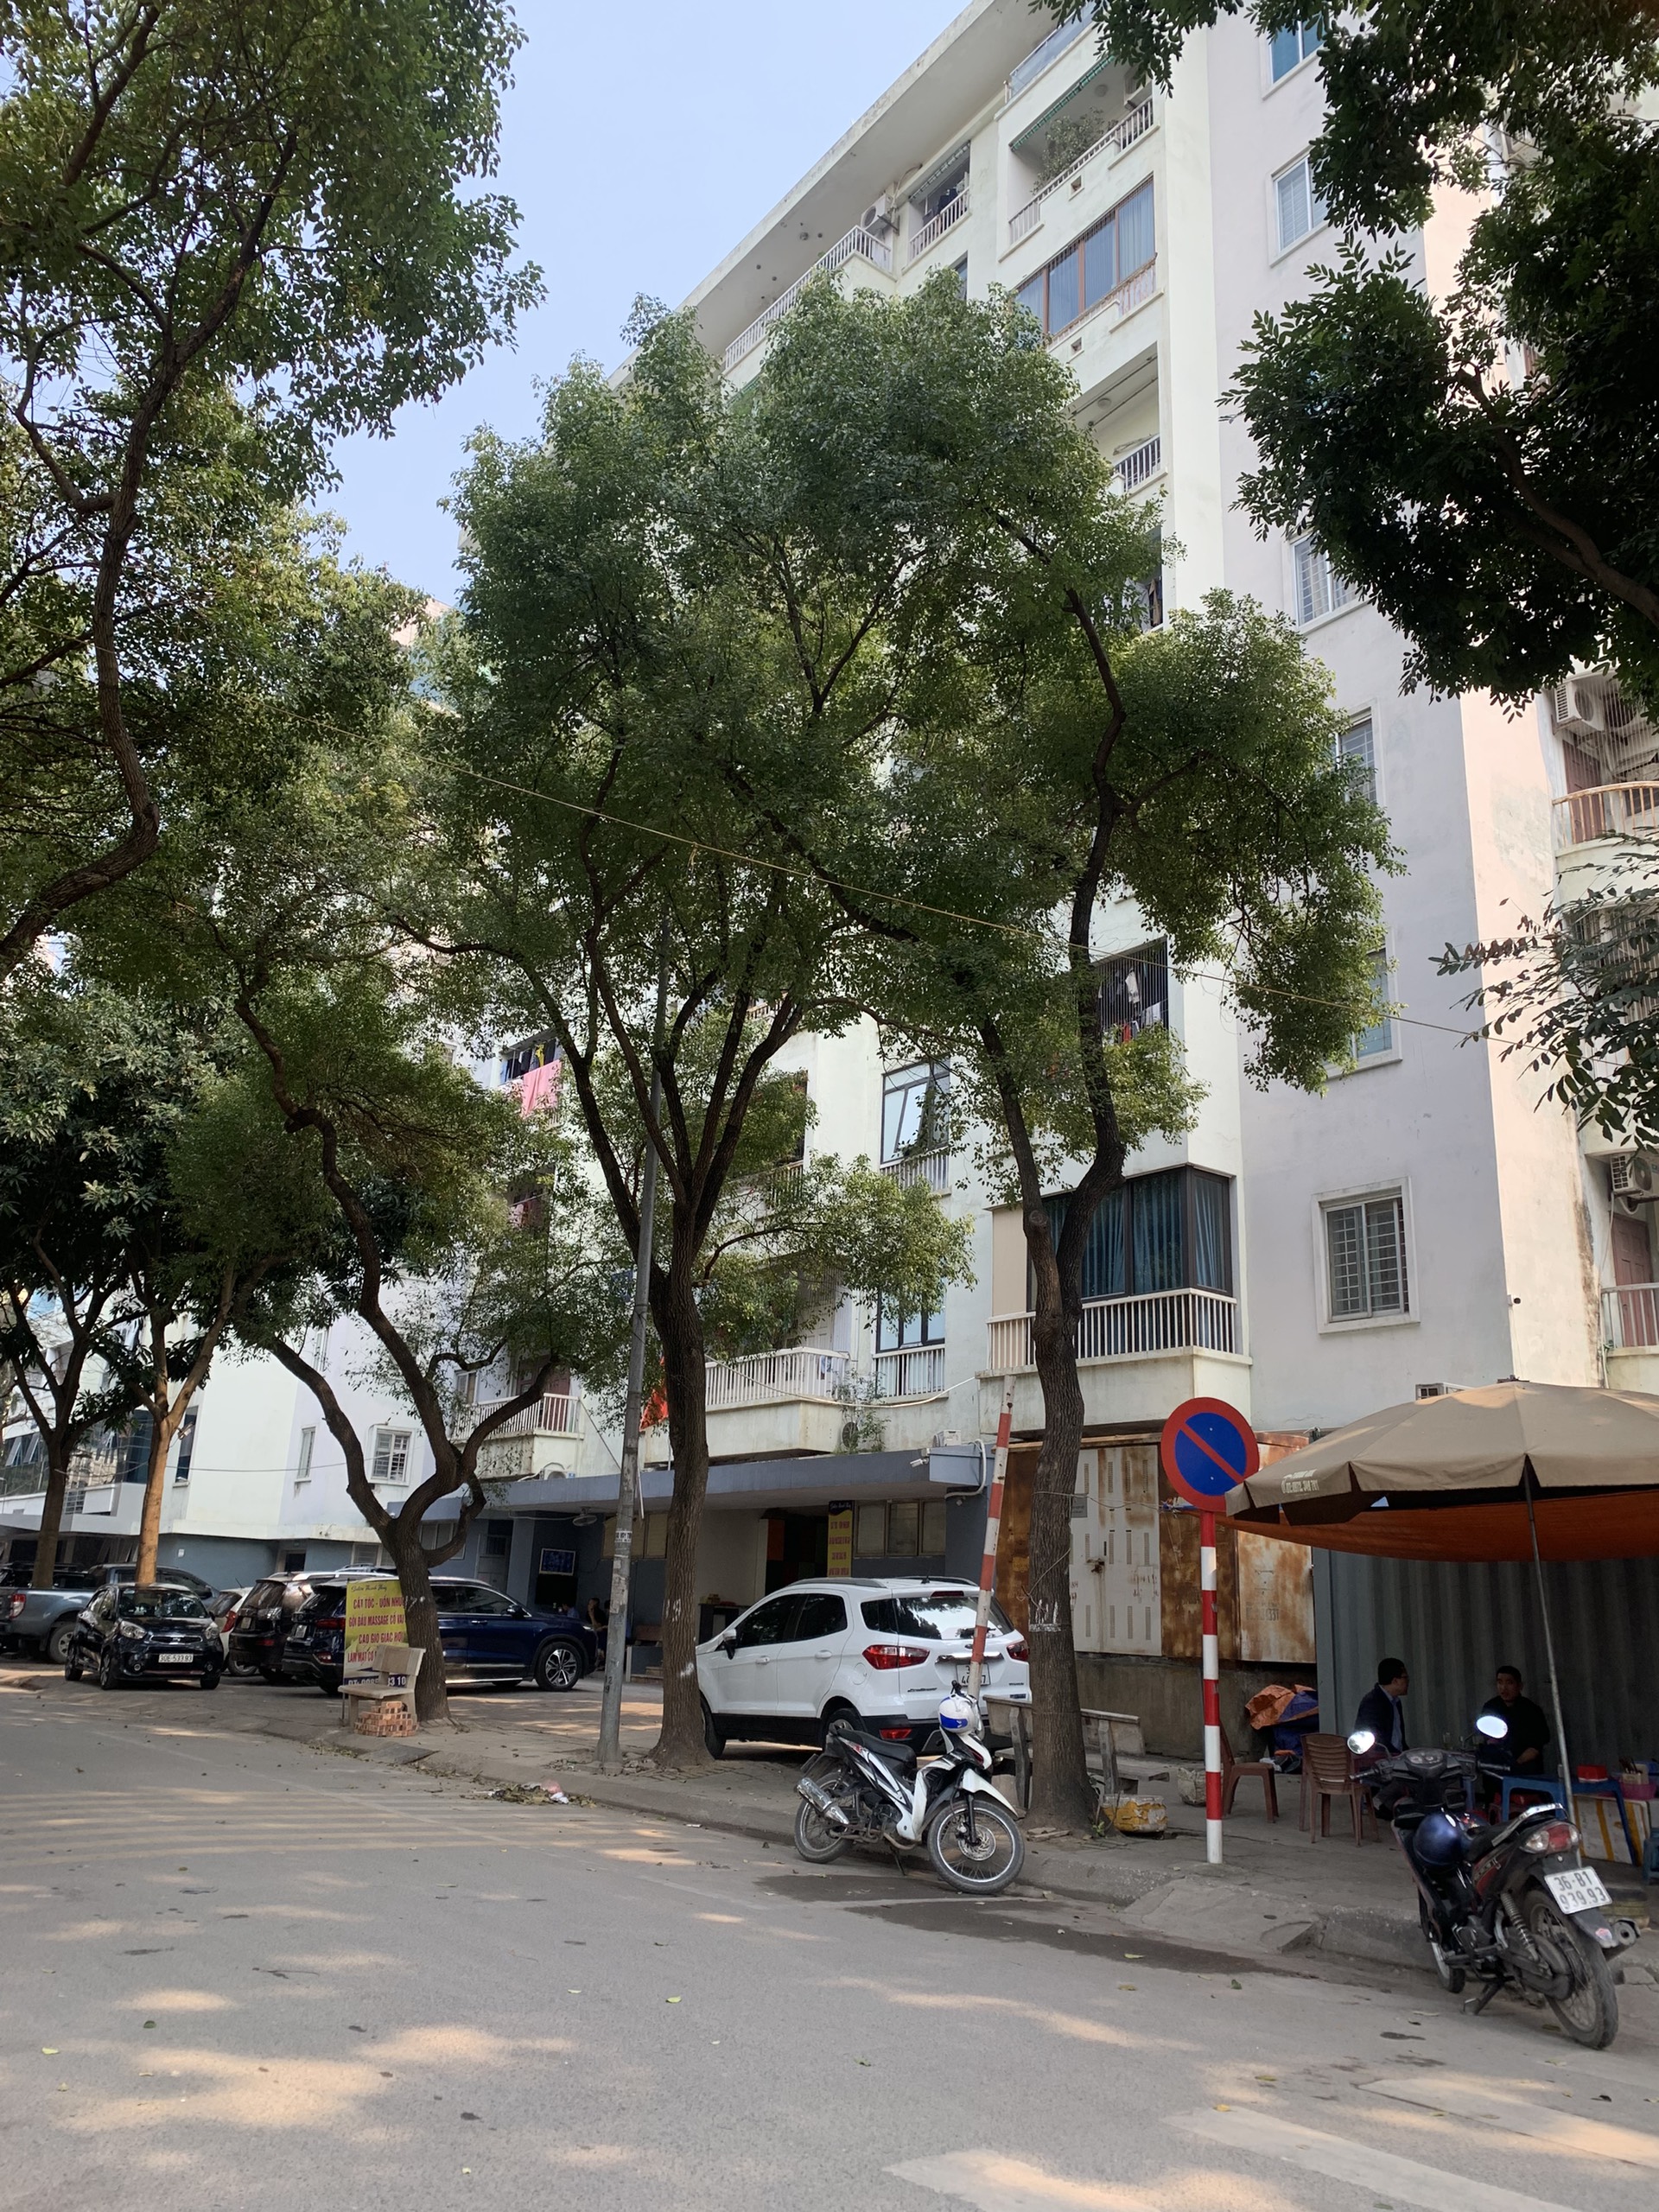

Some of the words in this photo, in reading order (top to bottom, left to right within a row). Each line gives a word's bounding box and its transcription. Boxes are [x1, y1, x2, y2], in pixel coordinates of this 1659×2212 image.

[367, 1615, 389, 1626] MASSAGE
[1554, 1871, 1592, 1891] 36-B1
[1559, 1886, 1607, 1910] 939.93
